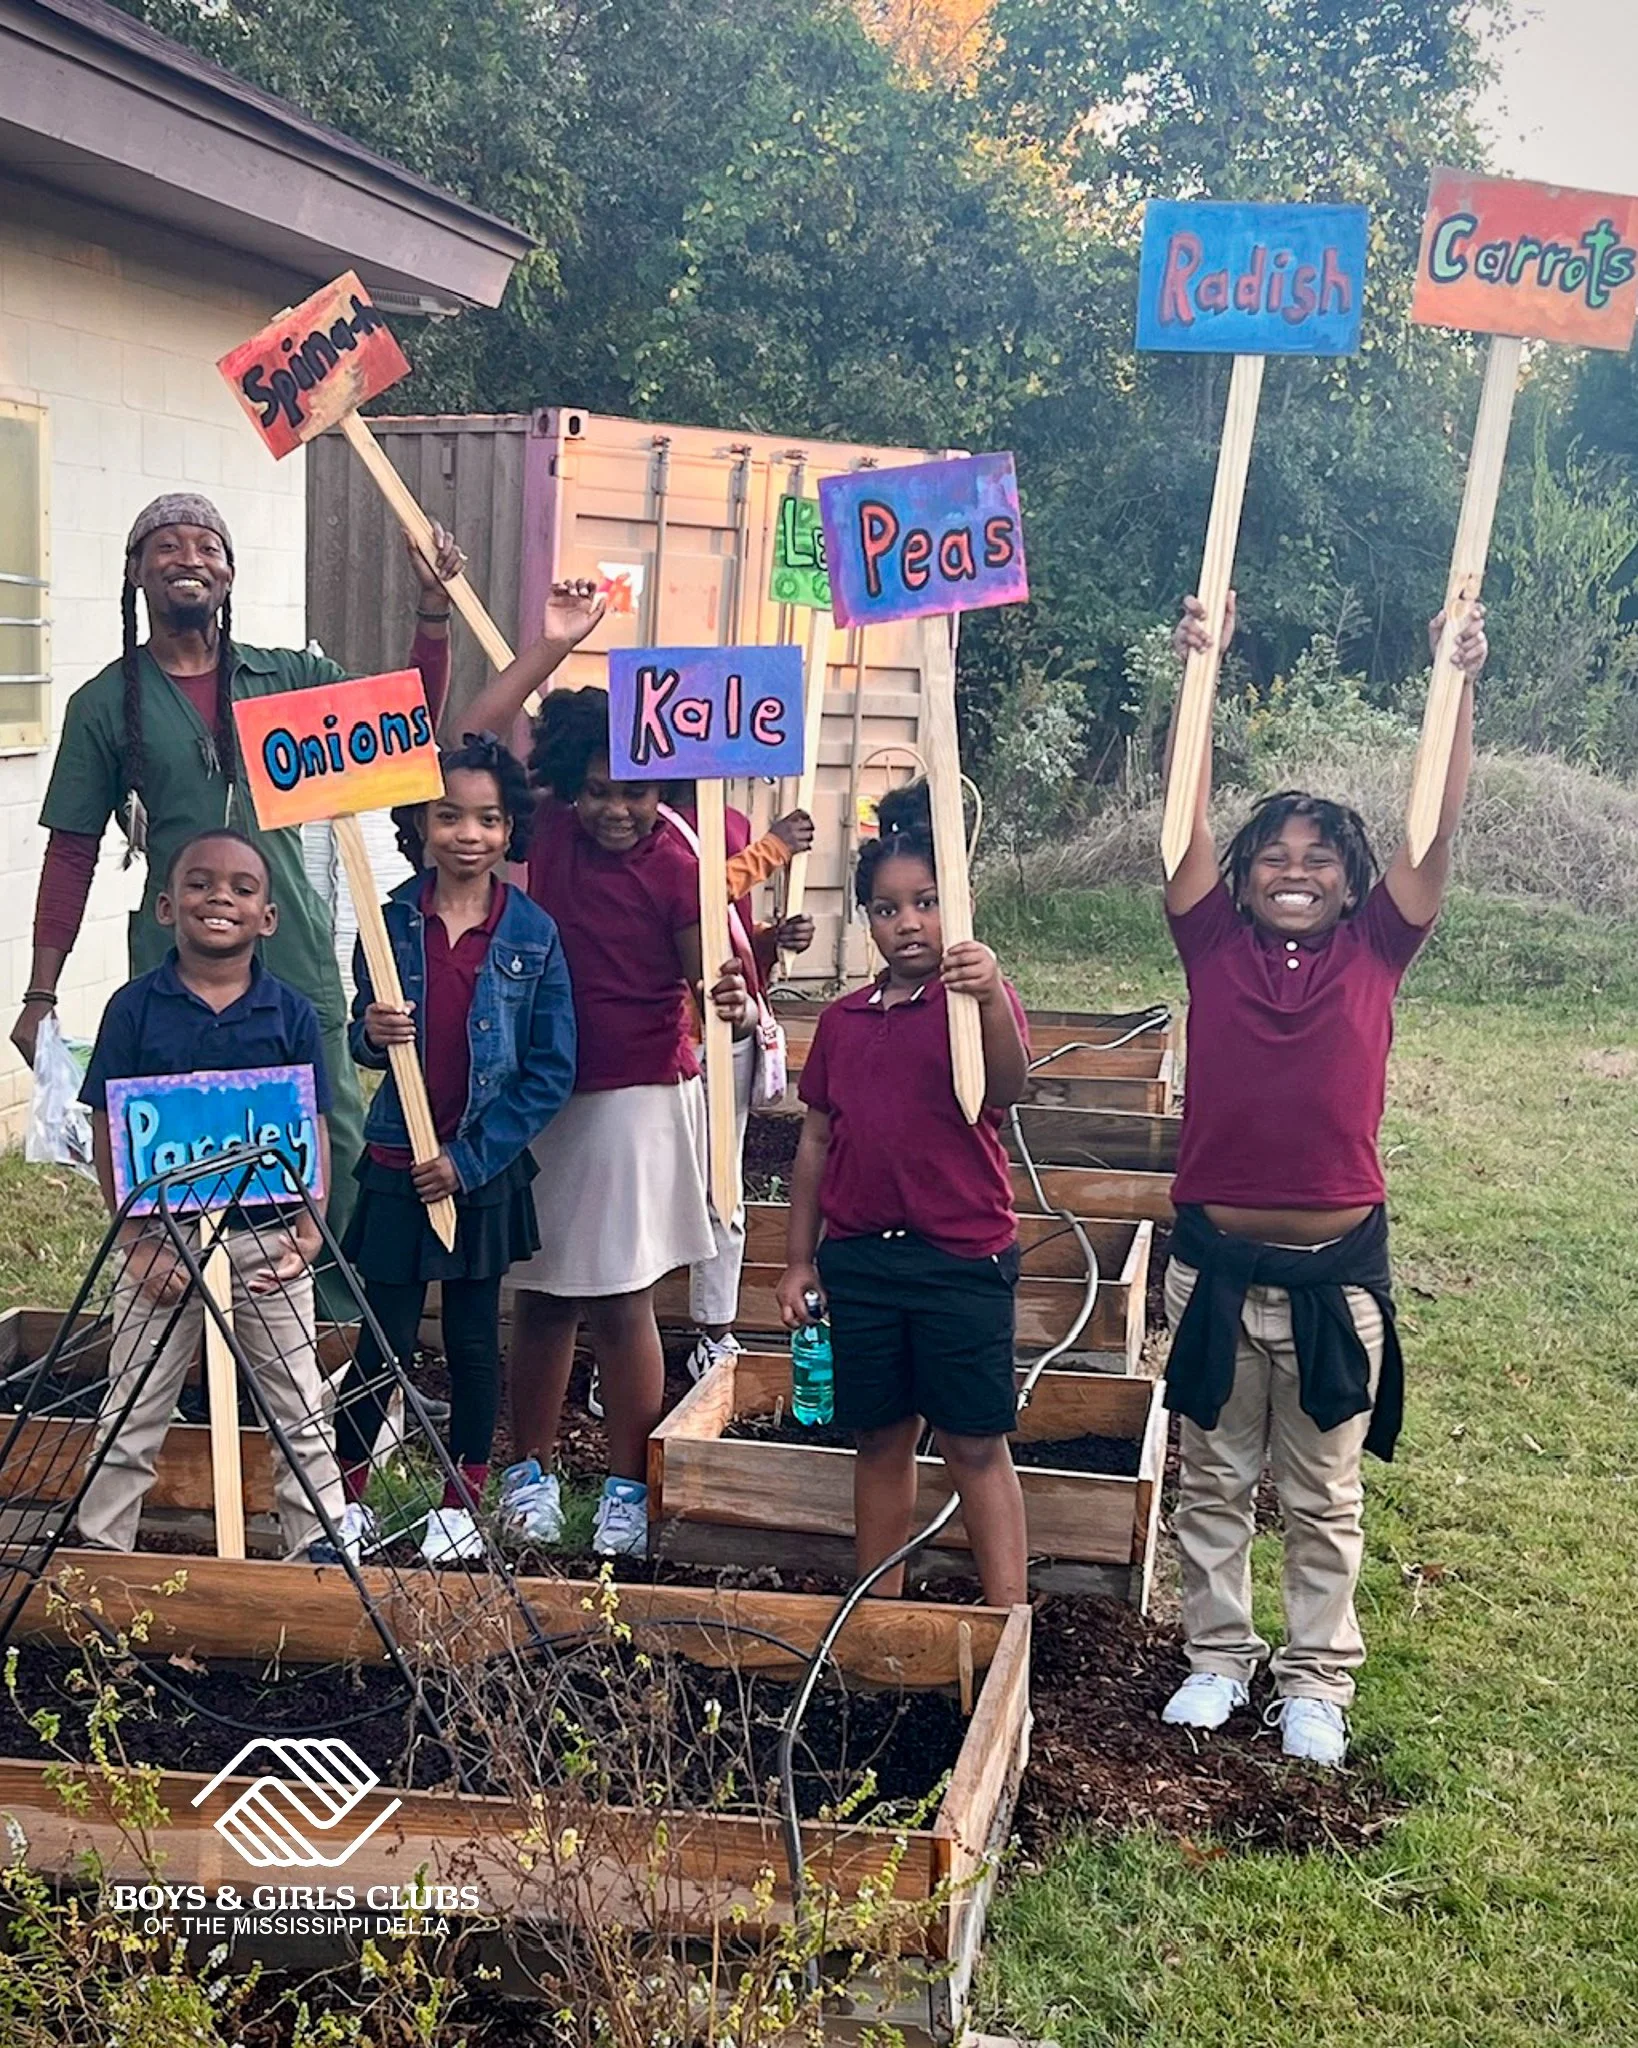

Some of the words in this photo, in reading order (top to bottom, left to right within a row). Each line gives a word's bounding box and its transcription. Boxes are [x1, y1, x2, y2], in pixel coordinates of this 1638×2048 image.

[1157, 231, 1352, 328] Radish
[1429, 212, 1637, 309] Carrots
[857, 499, 1015, 597] Peas
[262, 703, 432, 790] Onions
[630, 666, 787, 765] Kale
